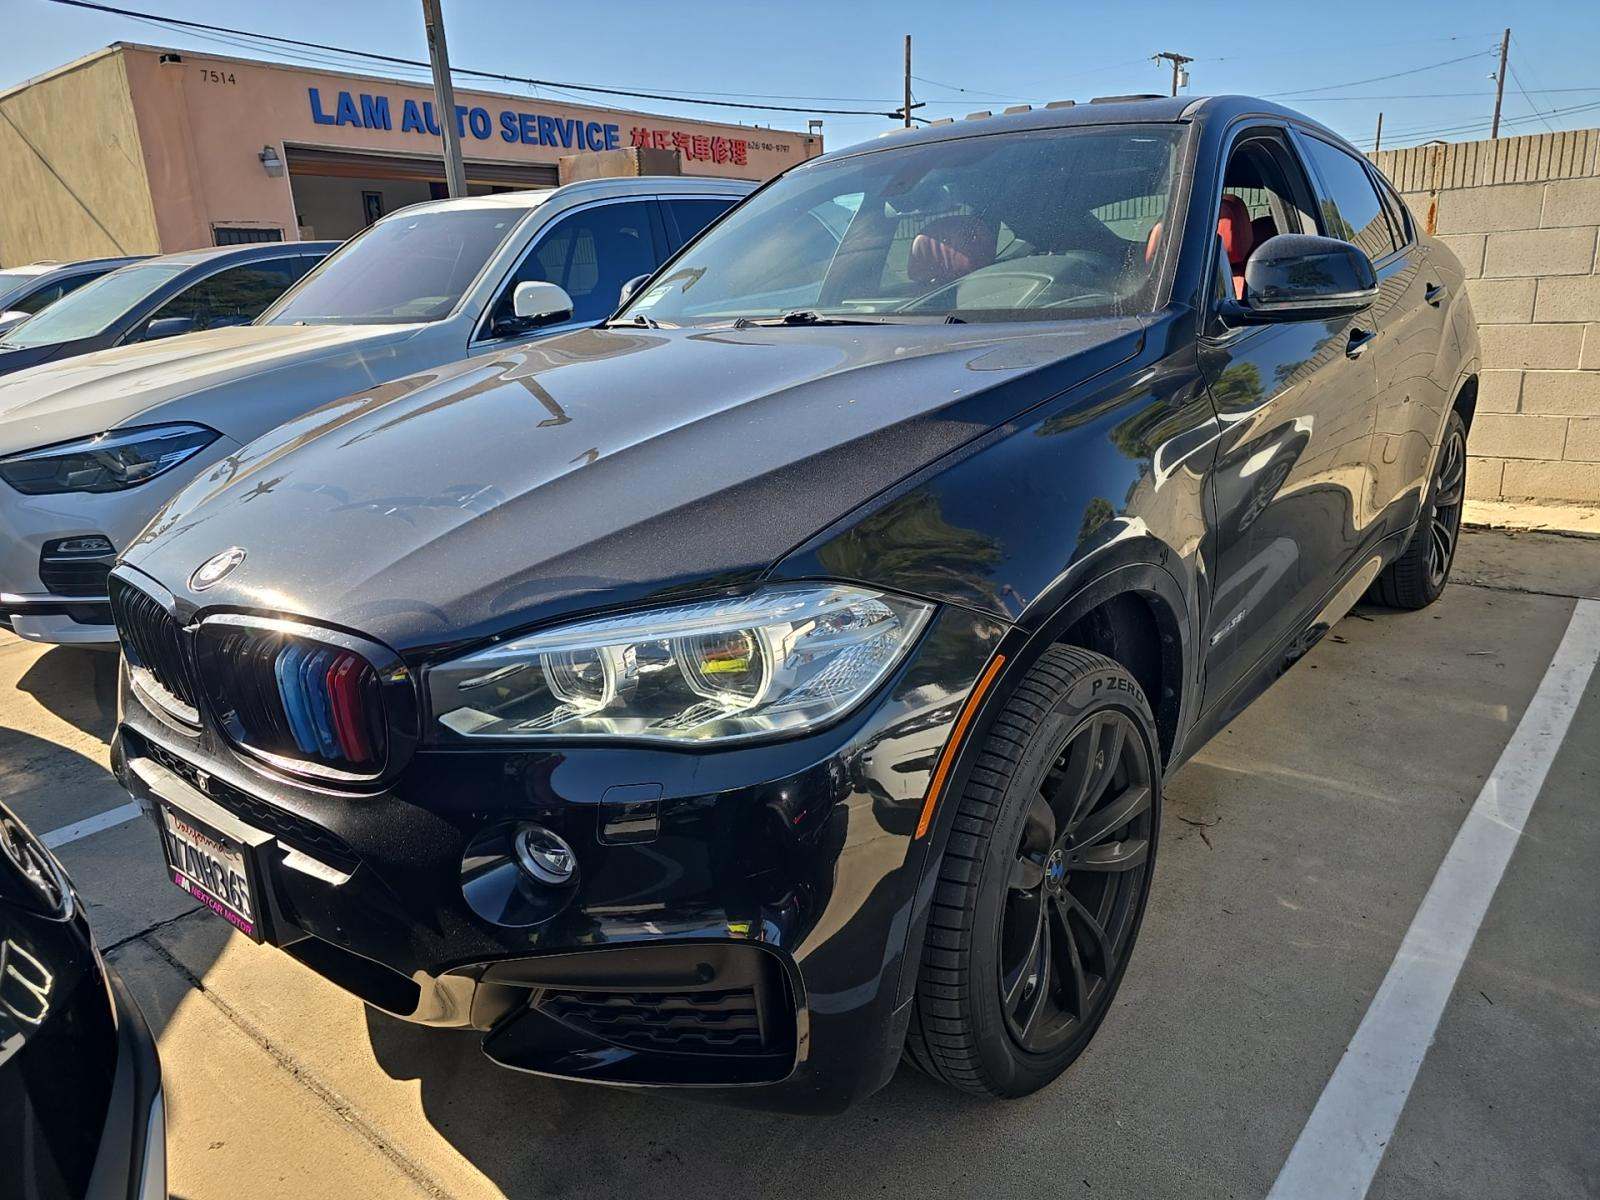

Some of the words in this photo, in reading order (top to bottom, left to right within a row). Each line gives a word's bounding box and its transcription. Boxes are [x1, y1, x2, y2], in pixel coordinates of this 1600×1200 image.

[200, 70, 236, 85] 7514
[308, 88, 392, 131] LAM
[402, 99, 492, 140] AUTO
[500, 111, 620, 151] SERVICE
[1091, 679, 1103, 696] P
[1106, 676, 1144, 704] ZERO
[224, 910, 253, 934] MOTOR
